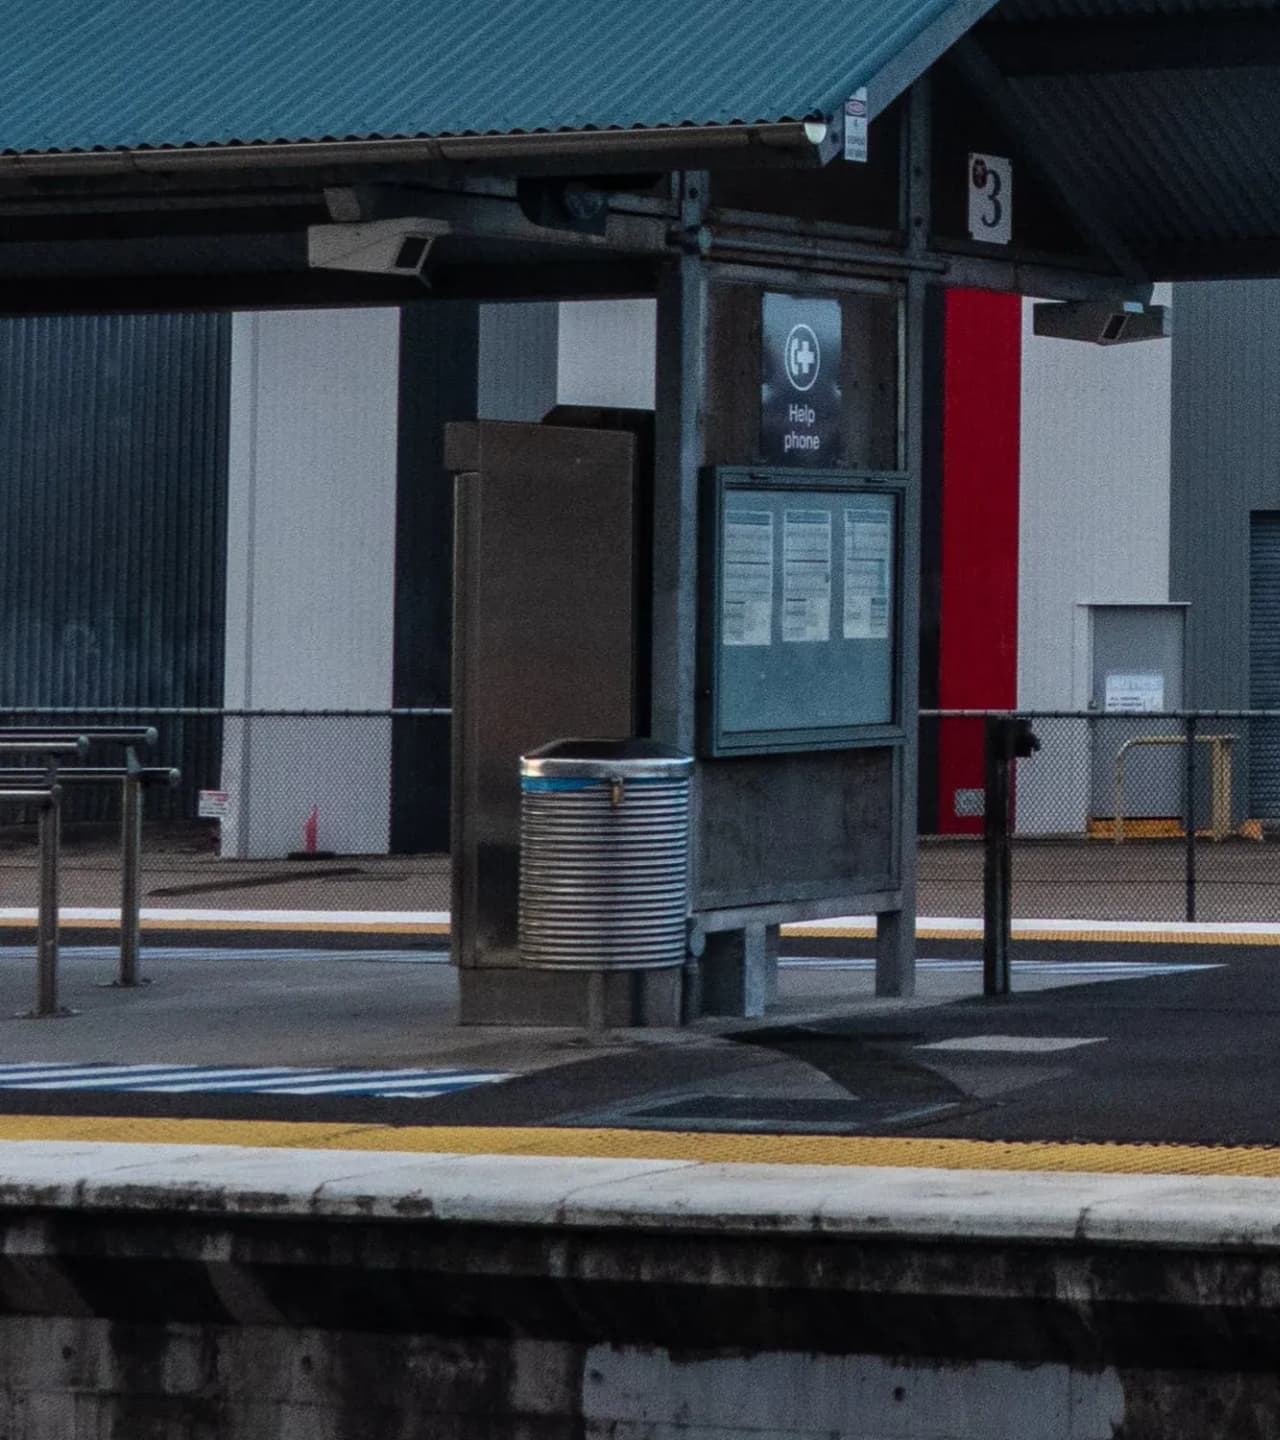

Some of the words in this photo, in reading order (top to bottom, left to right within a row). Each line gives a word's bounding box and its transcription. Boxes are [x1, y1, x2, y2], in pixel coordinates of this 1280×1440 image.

[981, 168, 1002, 228] 3
[789, 403, 816, 427] Help
[784, 430, 821, 453] phone
